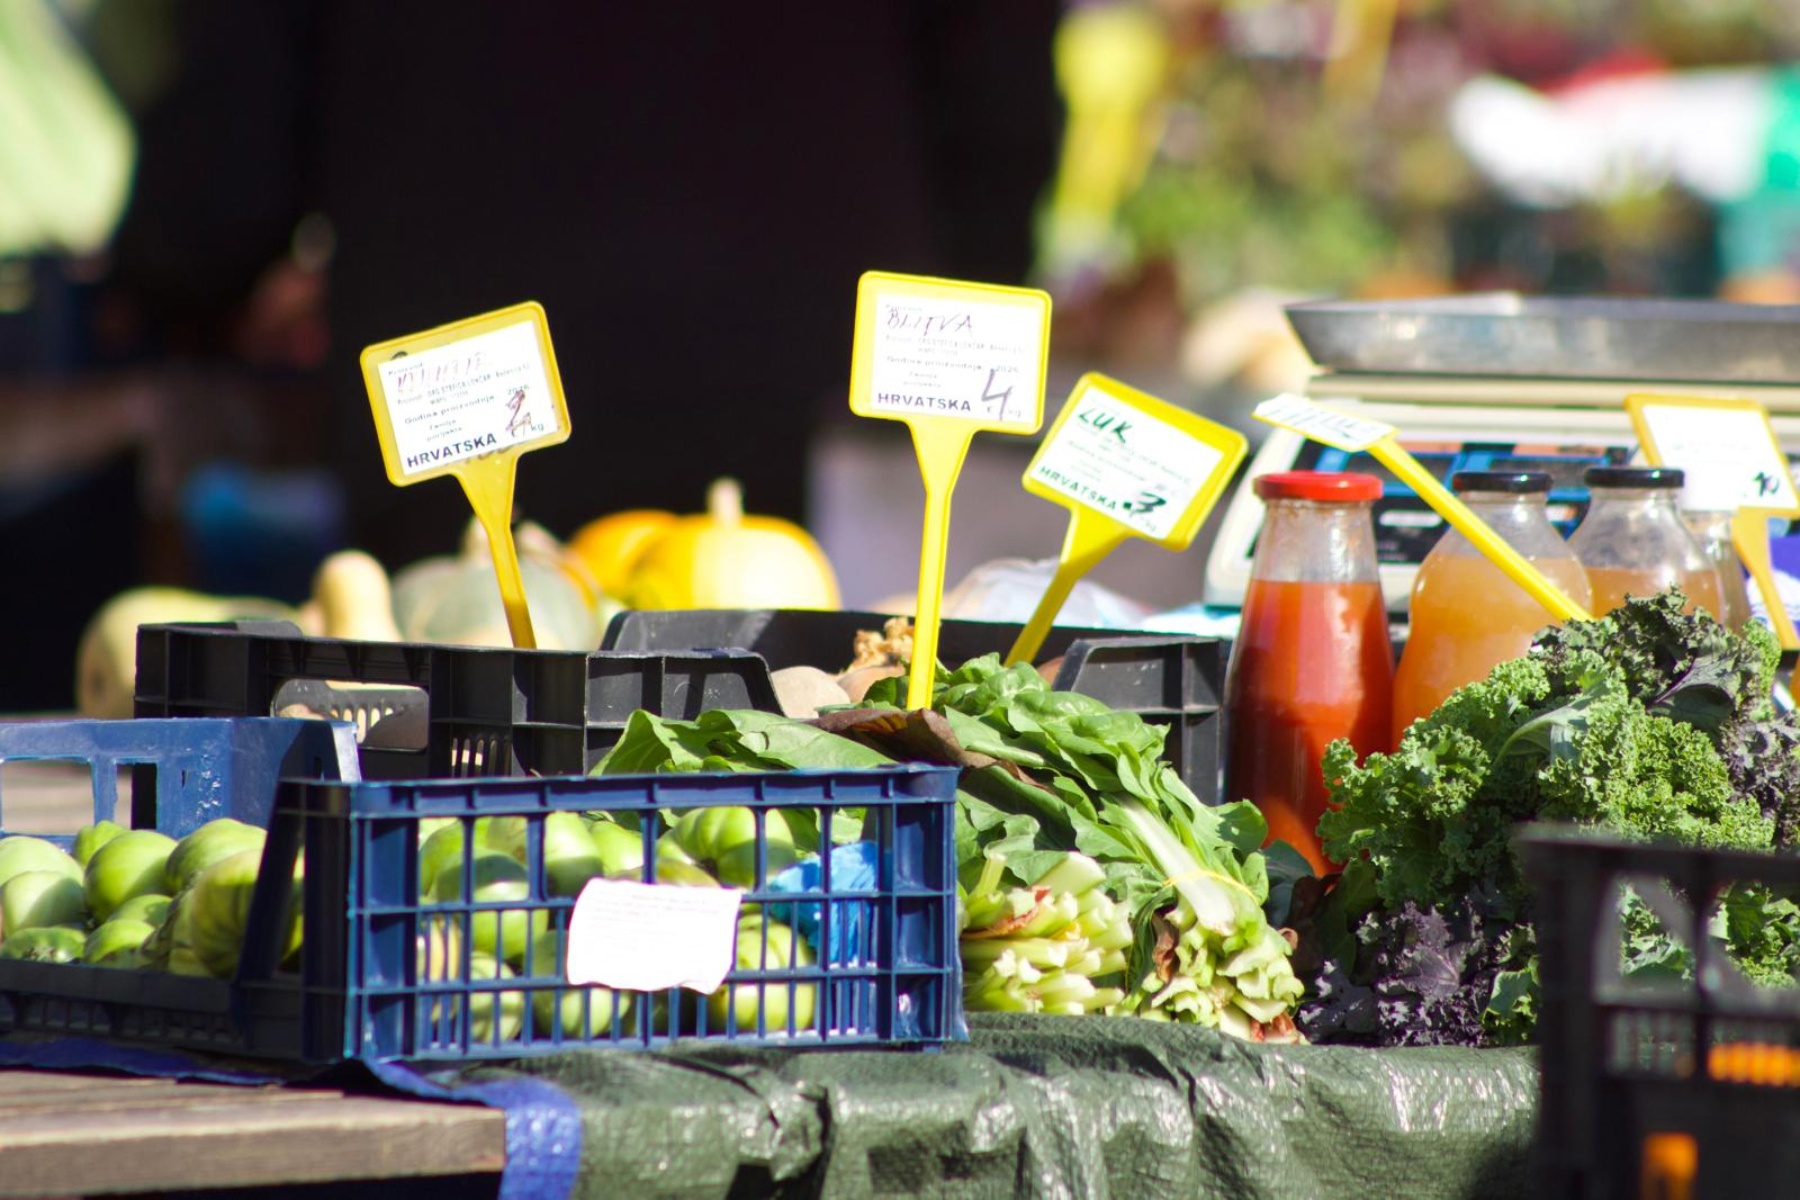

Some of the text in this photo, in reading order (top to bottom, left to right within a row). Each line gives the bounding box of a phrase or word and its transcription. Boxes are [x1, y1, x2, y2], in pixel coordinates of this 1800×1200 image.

[877, 392, 971, 411] HRVATSKA
[981, 368, 1012, 421] 4
[1078, 408, 1132, 443] LUK
[407, 433, 497, 467] HRVATSKA
[1038, 465, 1118, 510] HRVATSKA
